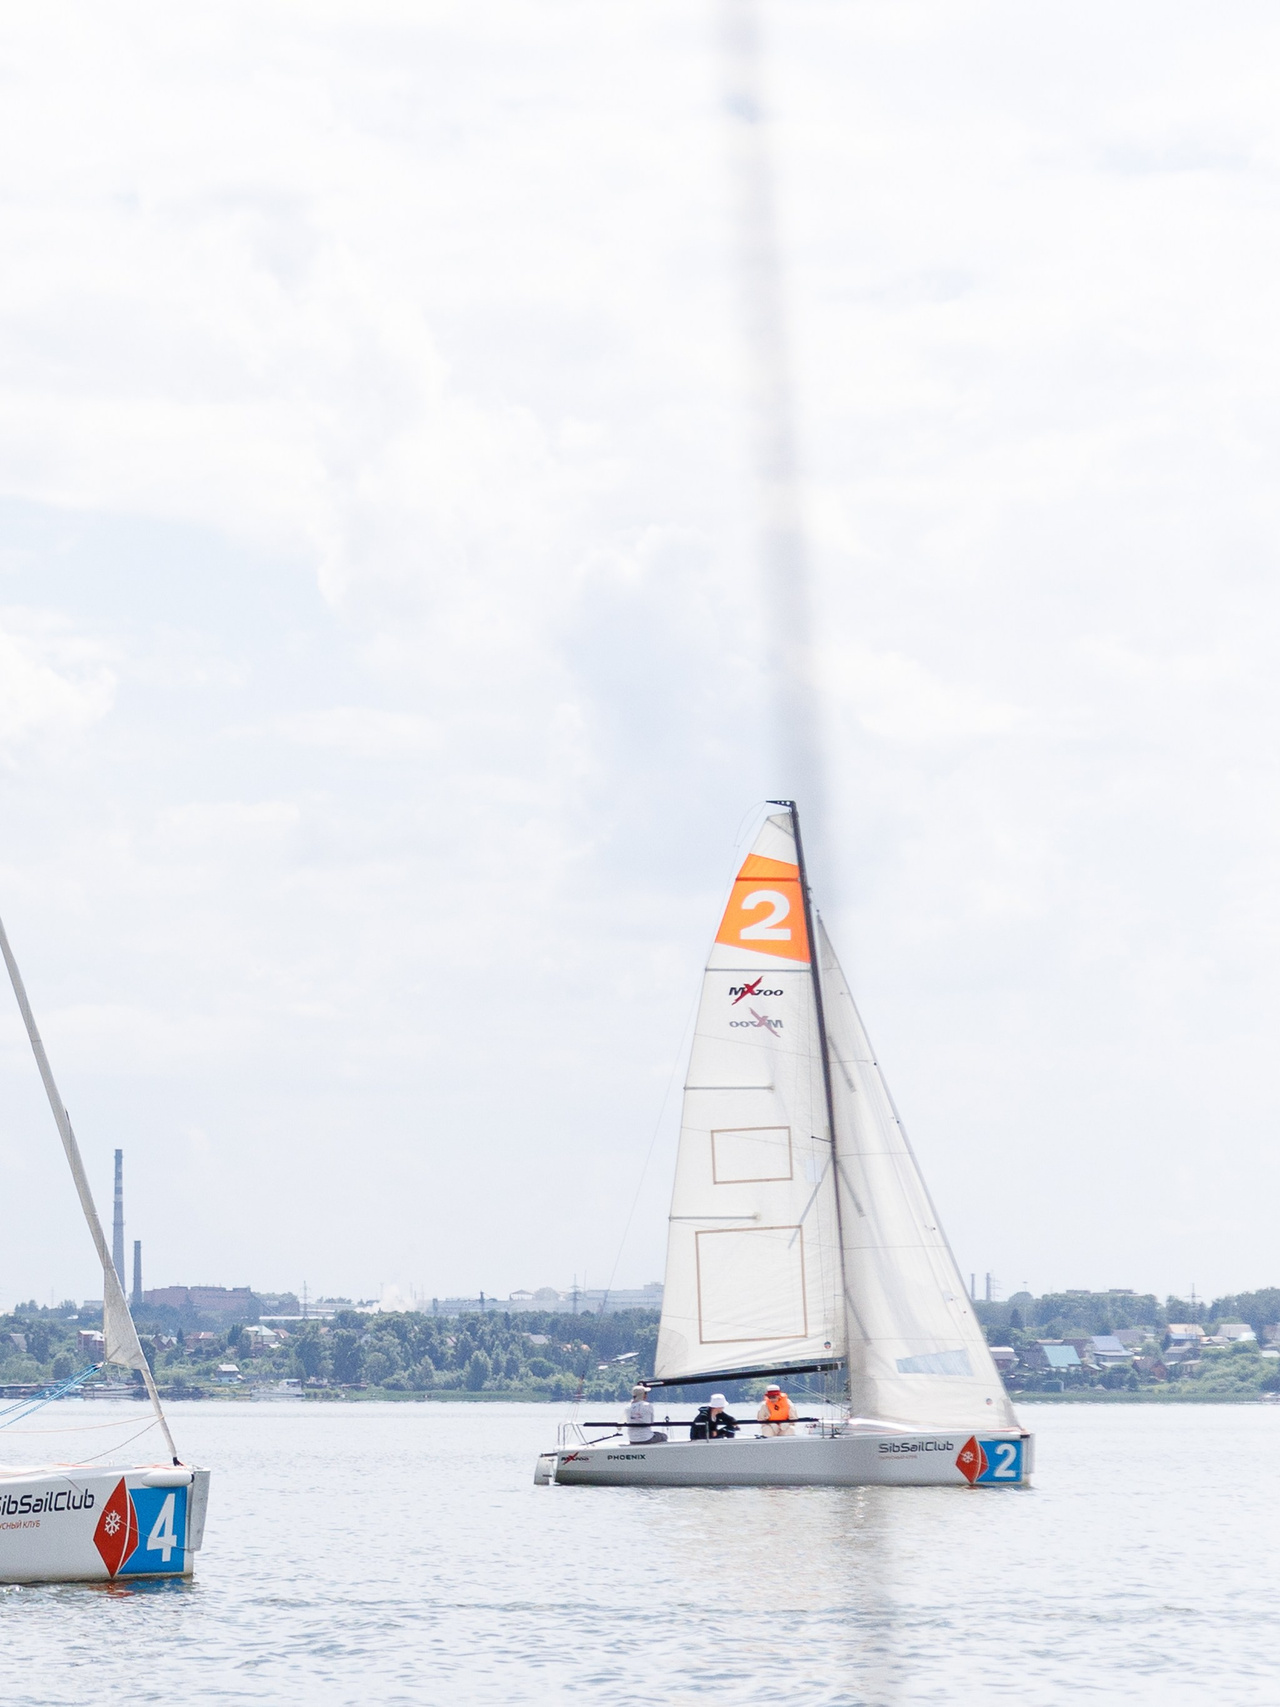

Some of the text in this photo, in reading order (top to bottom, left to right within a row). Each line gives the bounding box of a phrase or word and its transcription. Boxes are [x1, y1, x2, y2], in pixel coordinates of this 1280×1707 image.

[740, 890, 791, 940] 2
[728, 975, 784, 1006] MX700
[878, 1441, 955, 1453] SibSailClub
[994, 1443, 1017, 1478] 2
[23, 1520, 41, 1529] КЛУБ
[146, 1493, 178, 1563] 4
